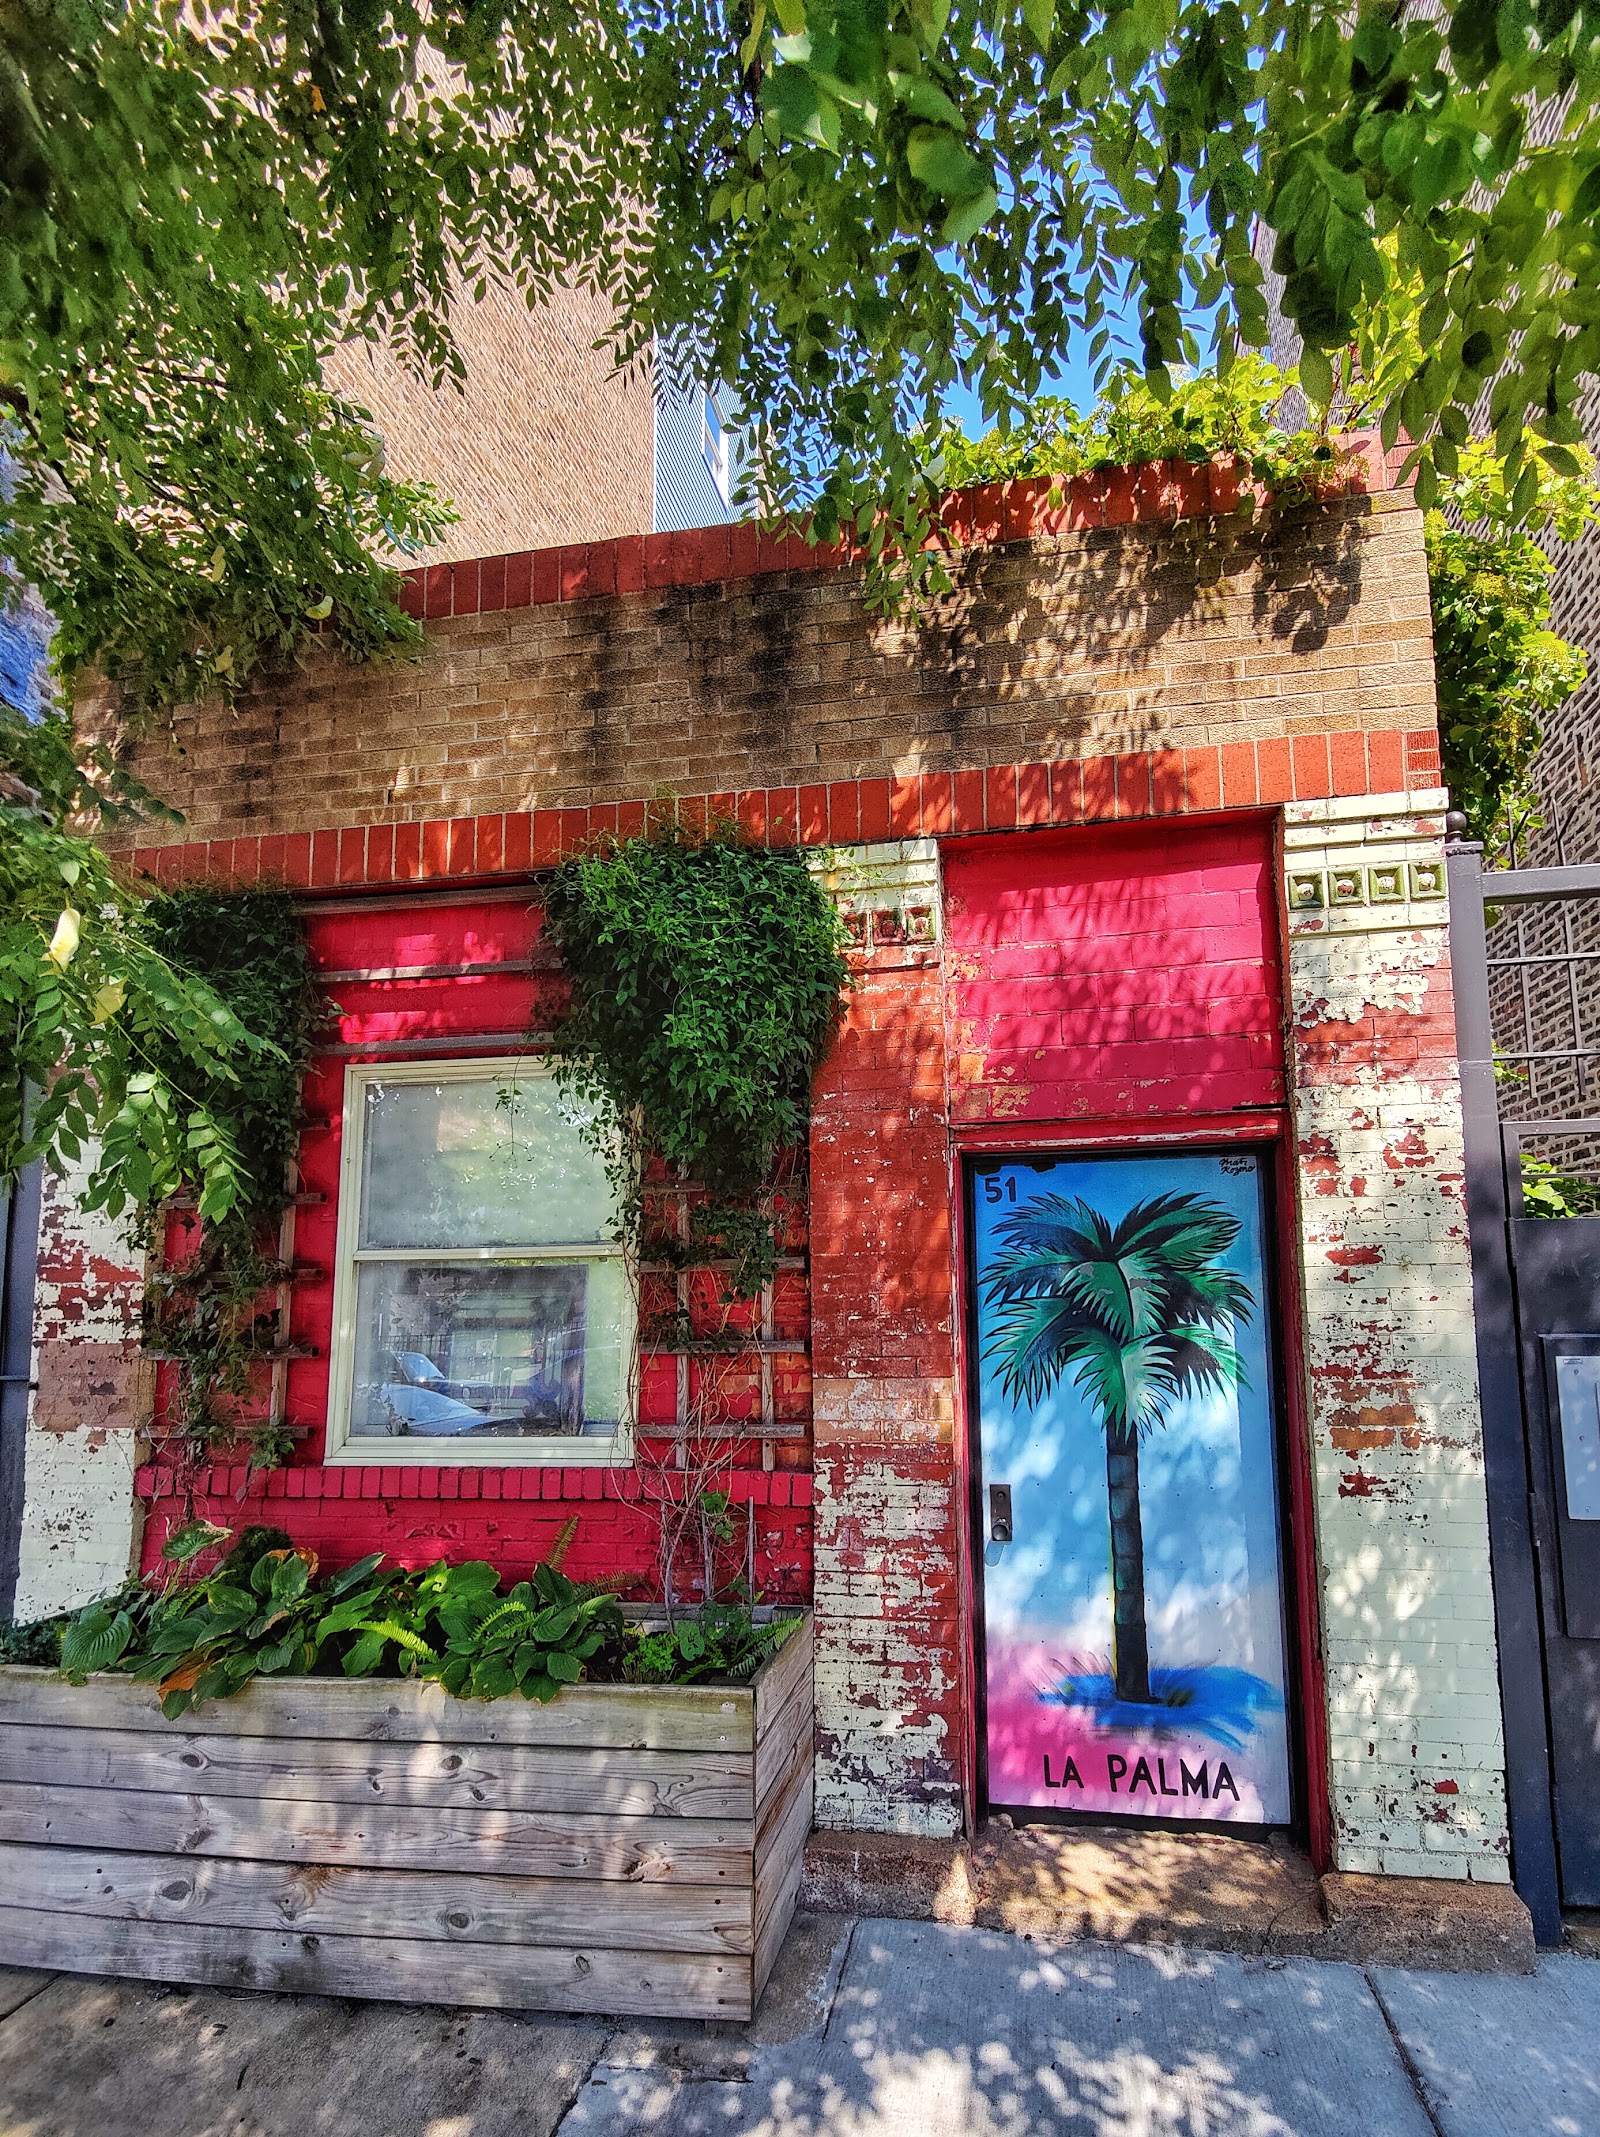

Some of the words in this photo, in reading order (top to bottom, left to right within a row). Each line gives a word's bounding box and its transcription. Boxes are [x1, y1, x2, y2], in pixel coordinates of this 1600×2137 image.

[984, 1176, 1017, 1203] 51
[1043, 1754, 1085, 1788] LA
[1106, 1754, 1241, 1801] PALMA
